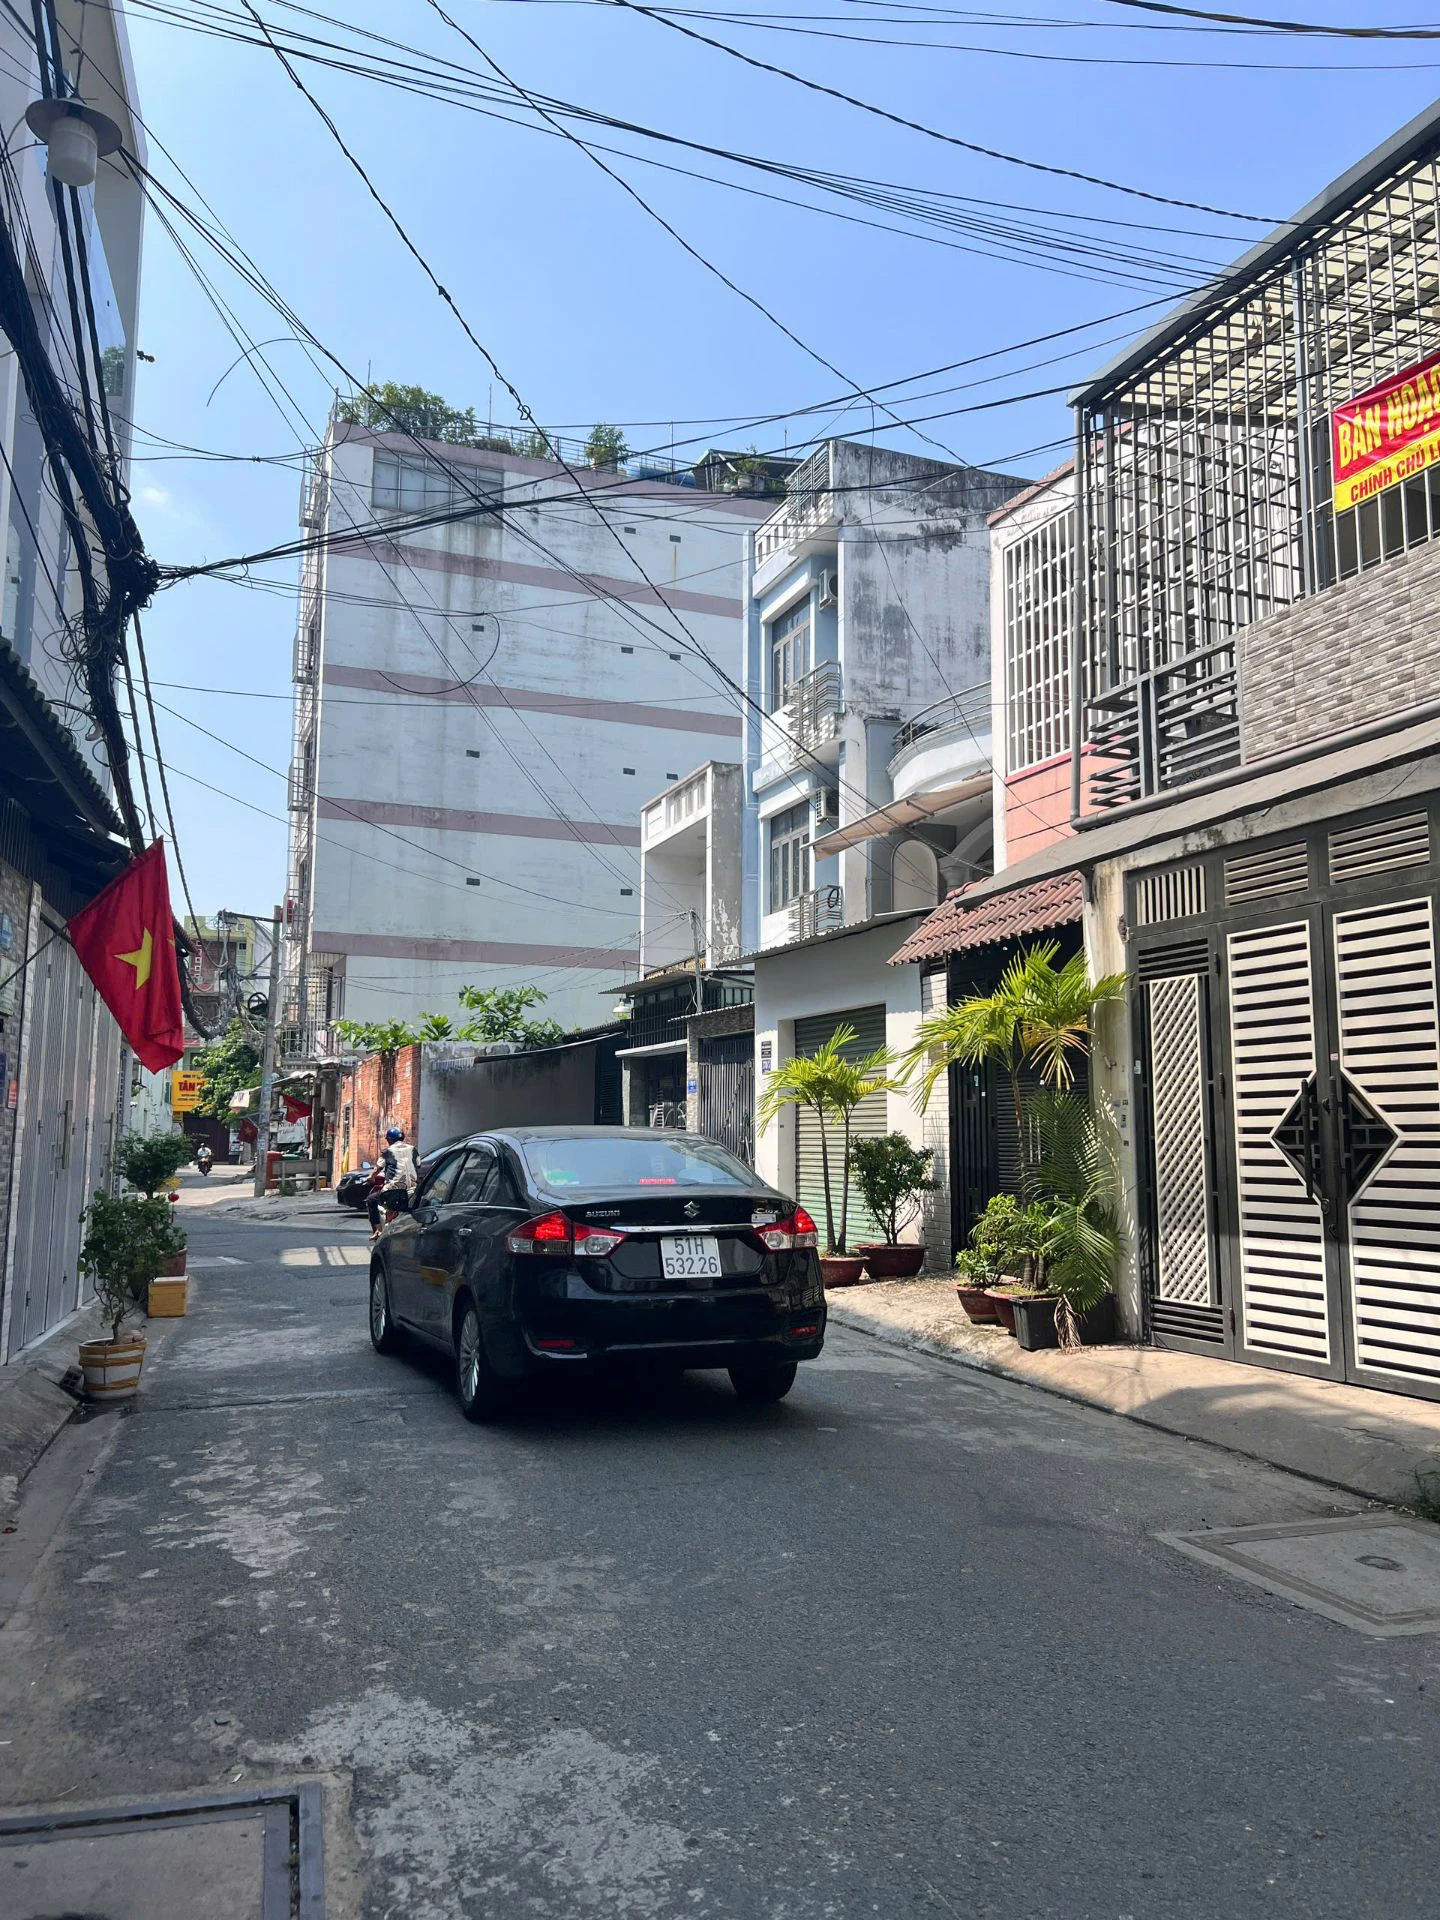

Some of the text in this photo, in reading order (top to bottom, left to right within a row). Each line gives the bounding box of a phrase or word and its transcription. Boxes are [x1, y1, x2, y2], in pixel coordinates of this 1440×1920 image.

[1338, 404, 1382, 468] BÁN
[1351, 466, 1393, 502] CHÍNH
[1396, 444, 1426, 477] CHỦ
[674, 1237, 704, 1255] 51H
[665, 1256, 717, 1275] 532.26
